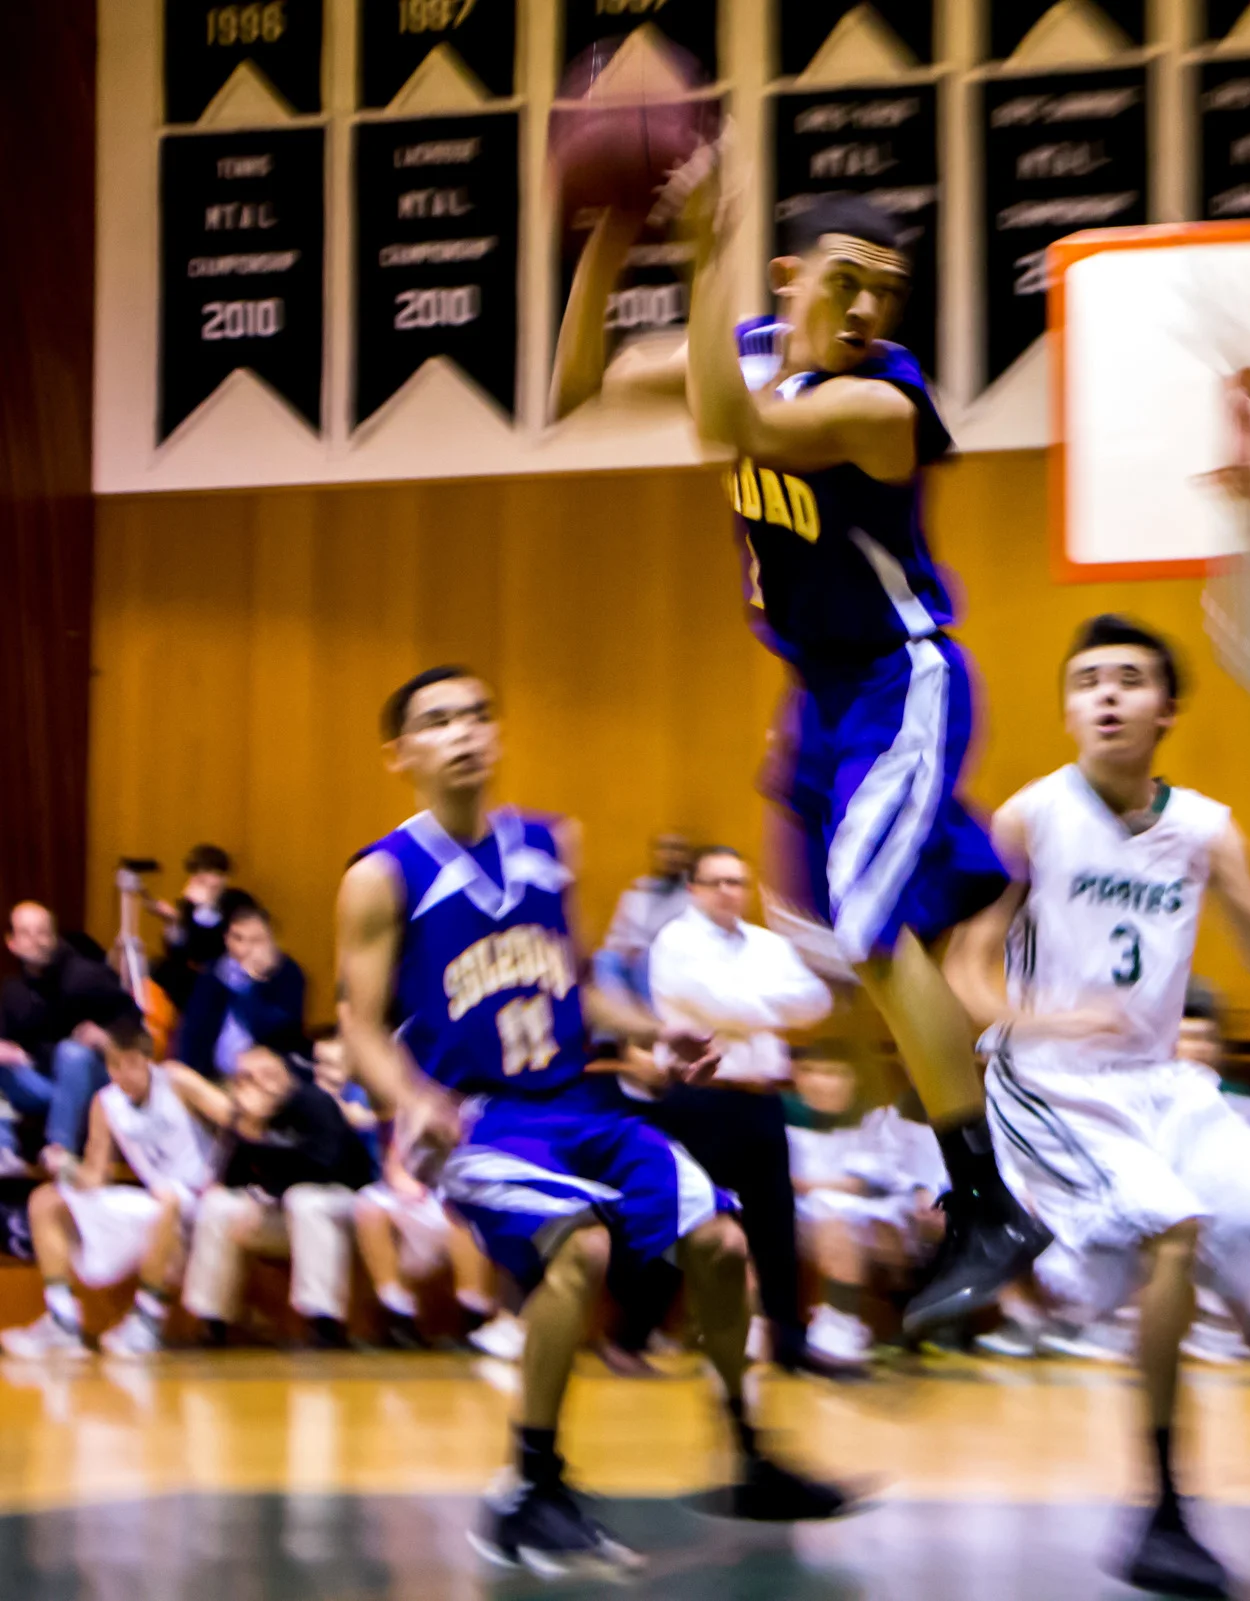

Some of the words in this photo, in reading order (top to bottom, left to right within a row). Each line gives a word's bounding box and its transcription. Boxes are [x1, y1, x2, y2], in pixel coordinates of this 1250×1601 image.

[201, 298, 284, 340] 2010
[394, 284, 481, 330] 2010
[1108, 921, 1143, 988] 3
